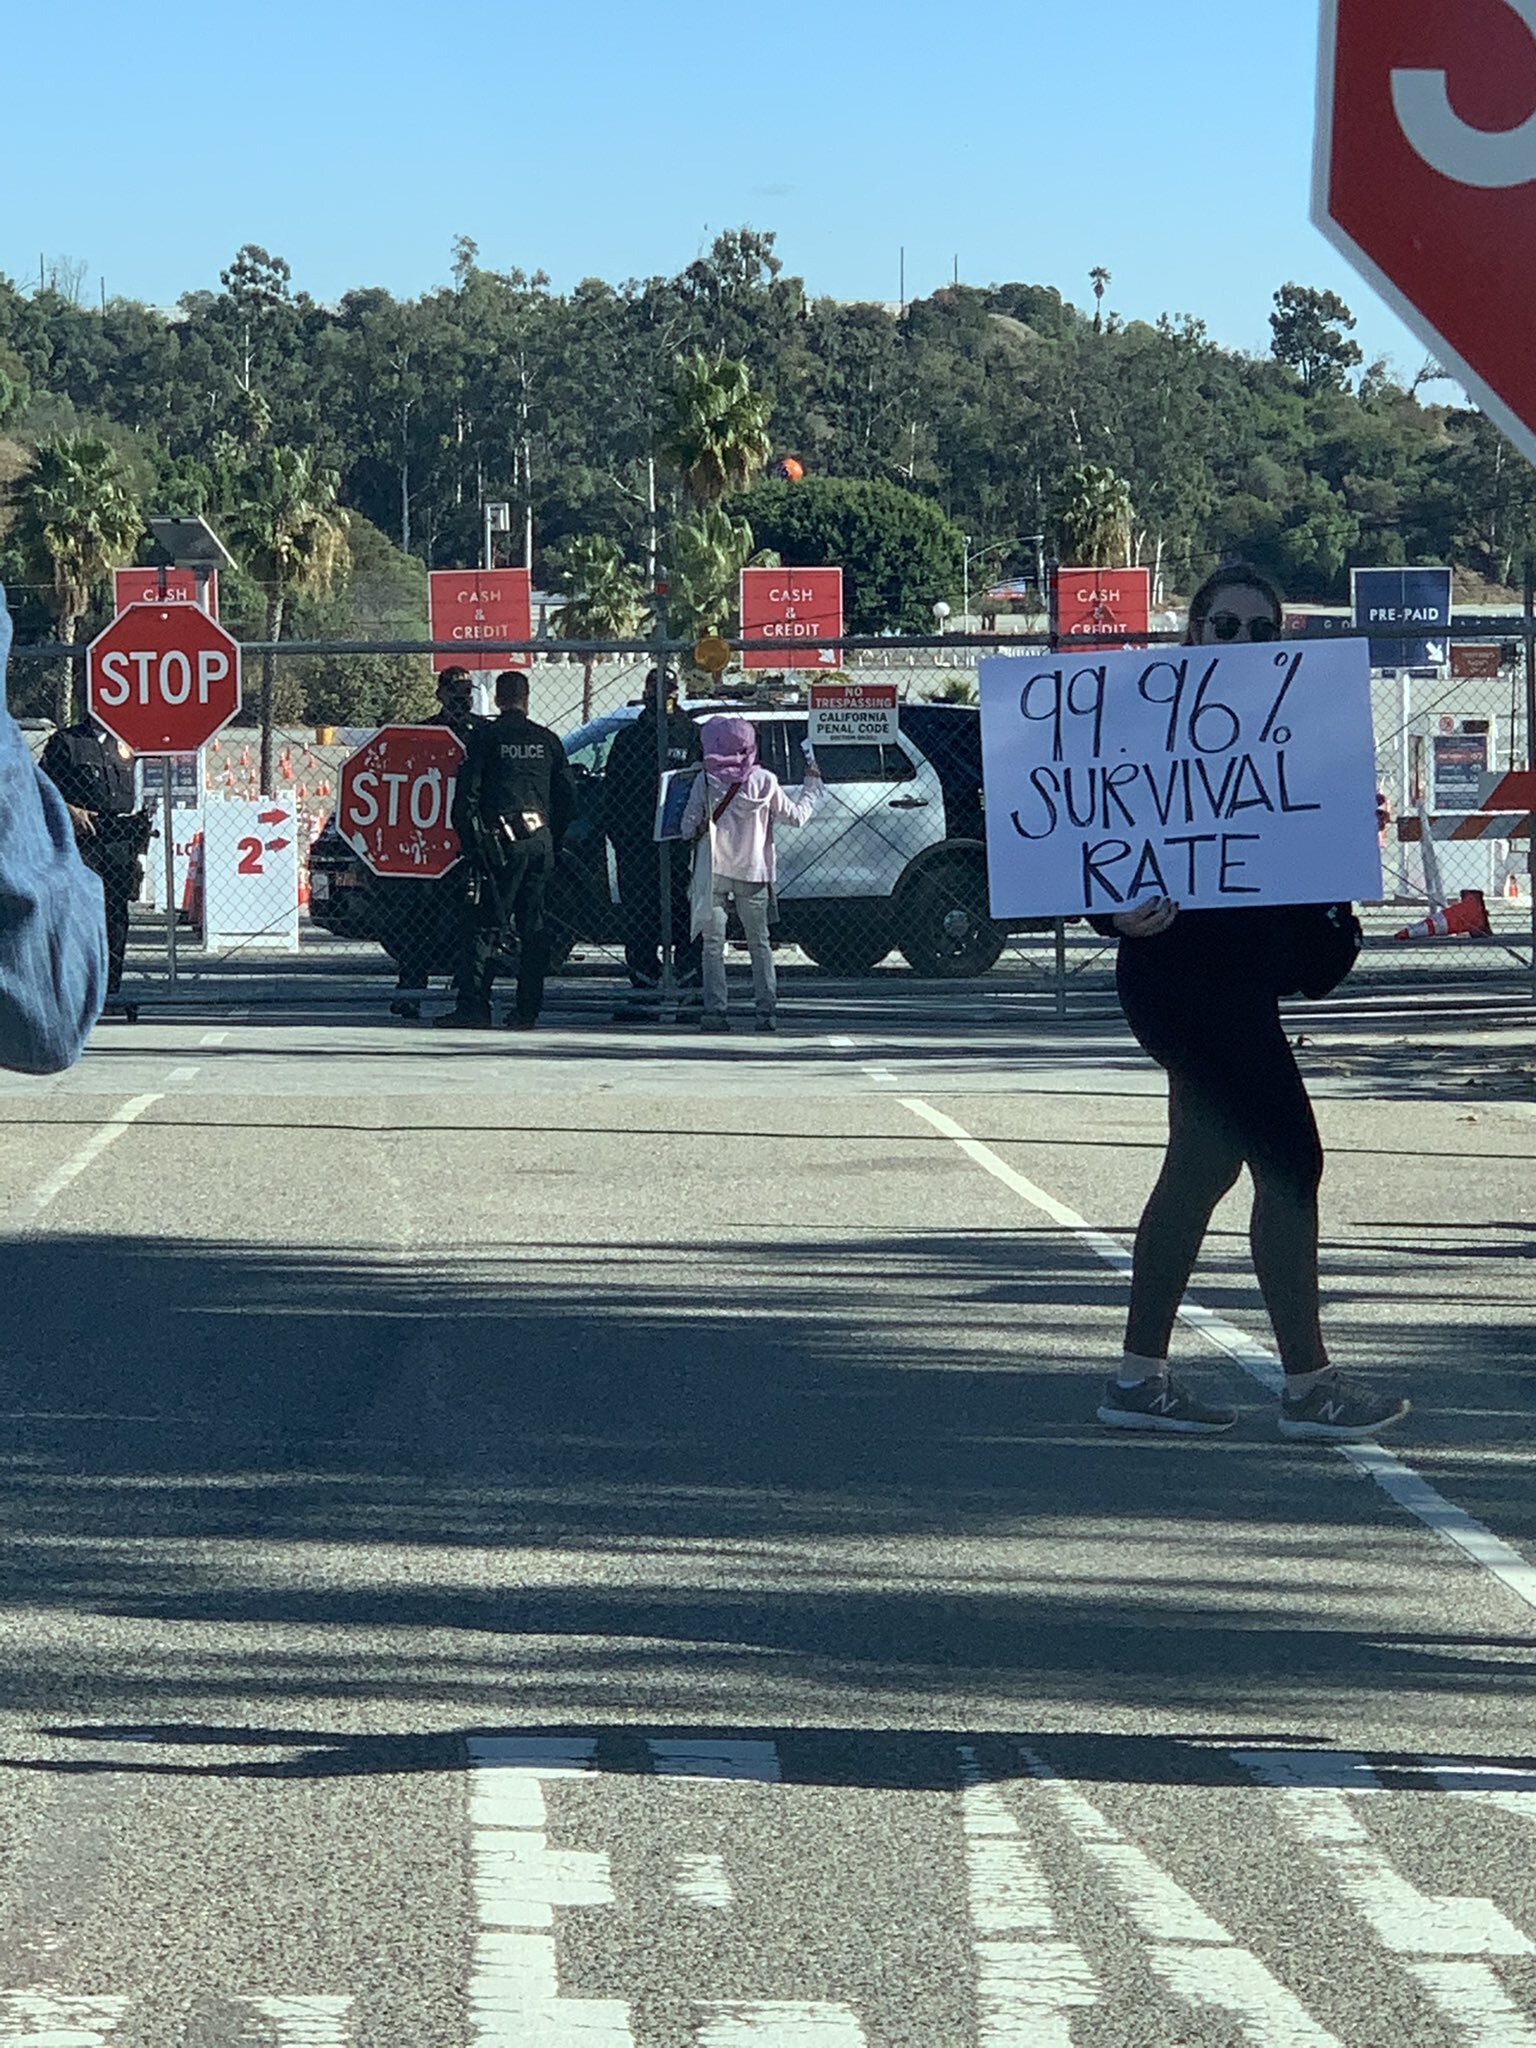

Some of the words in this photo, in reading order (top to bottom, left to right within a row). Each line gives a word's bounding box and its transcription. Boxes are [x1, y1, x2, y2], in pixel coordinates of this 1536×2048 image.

[457, 589, 501, 603] CASH
[769, 588, 813, 602] CASH
[1077, 589, 1120, 602] CASH
[785, 607, 796, 619] &
[1369, 608, 1439, 622] PRE-PAID
[452, 625, 508, 639] CREDIT
[763, 623, 819, 637] CREDIT
[100, 650, 229, 706] STOP
[845, 687, 863, 697] NO
[816, 697, 892, 708] TRESPASSING
[819, 712, 888, 722] CALIFORNIA
[816, 723, 855, 734] PENAL
[858, 723, 890, 733] CODE
[501, 744, 545, 759] POLICE
[1010, 751, 1321, 839] SURVIVAL
[238, 837, 264, 874] 2
[1082, 834, 1261, 908] RATE
